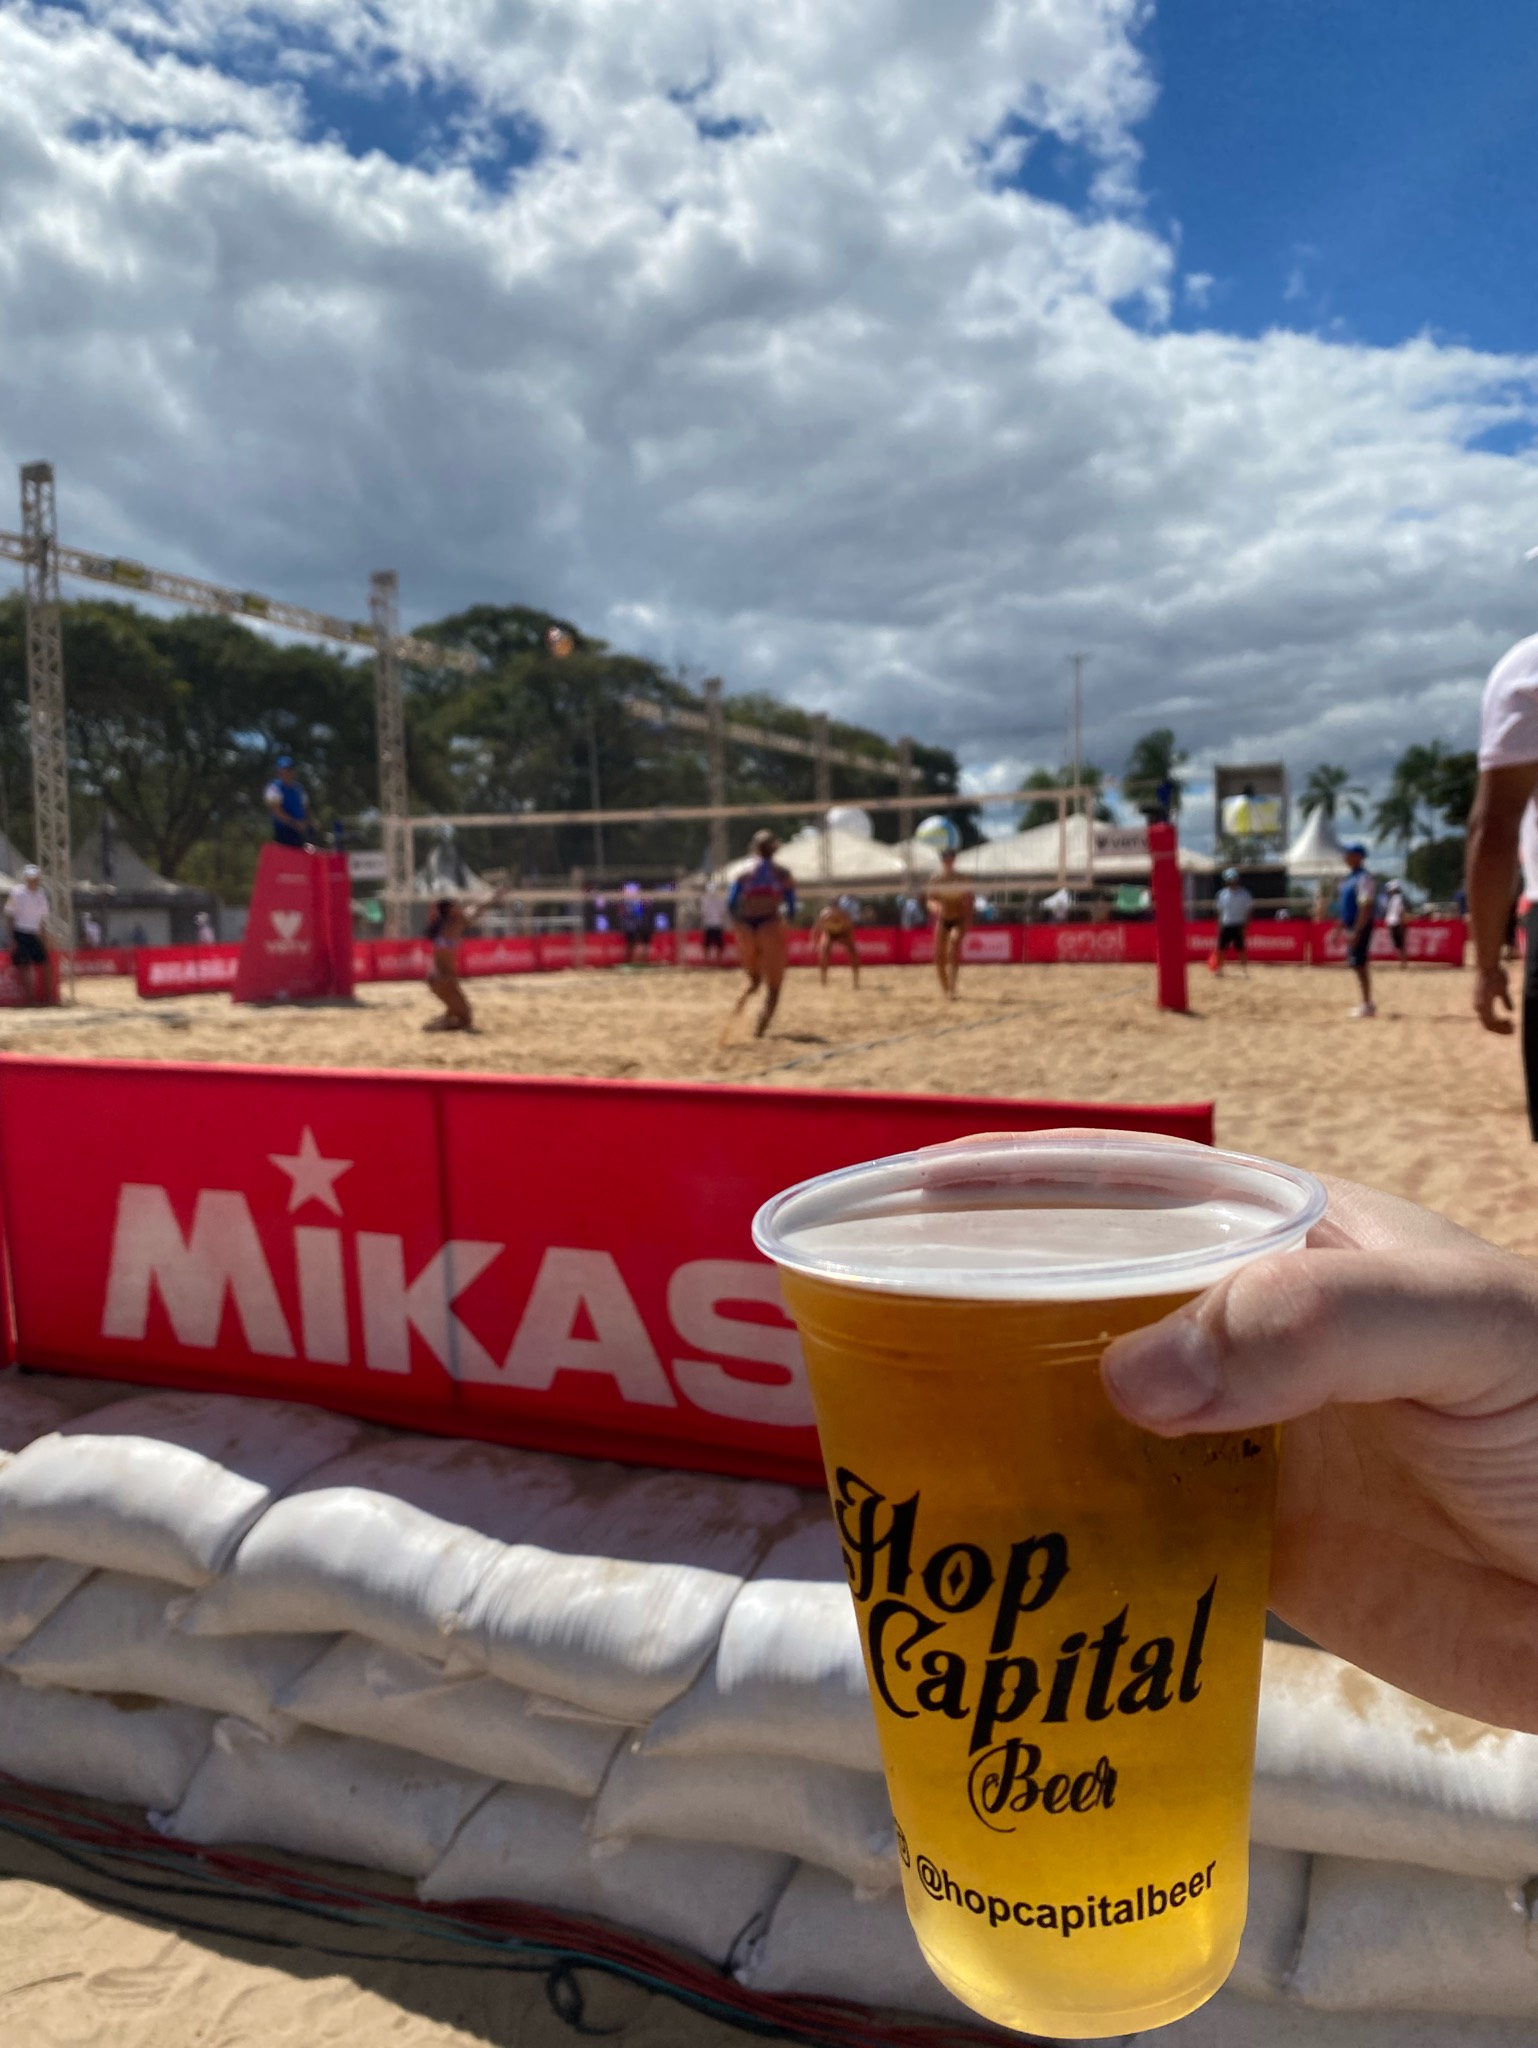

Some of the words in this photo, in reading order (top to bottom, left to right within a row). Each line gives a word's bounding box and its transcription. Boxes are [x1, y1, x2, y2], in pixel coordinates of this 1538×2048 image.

[835, 1466, 1070, 1654] Hop
[868, 1573, 1218, 1757] Capital
[967, 1737, 1118, 1833] Beer
[917, 1854, 1217, 1938] @hopcapitalbeer
